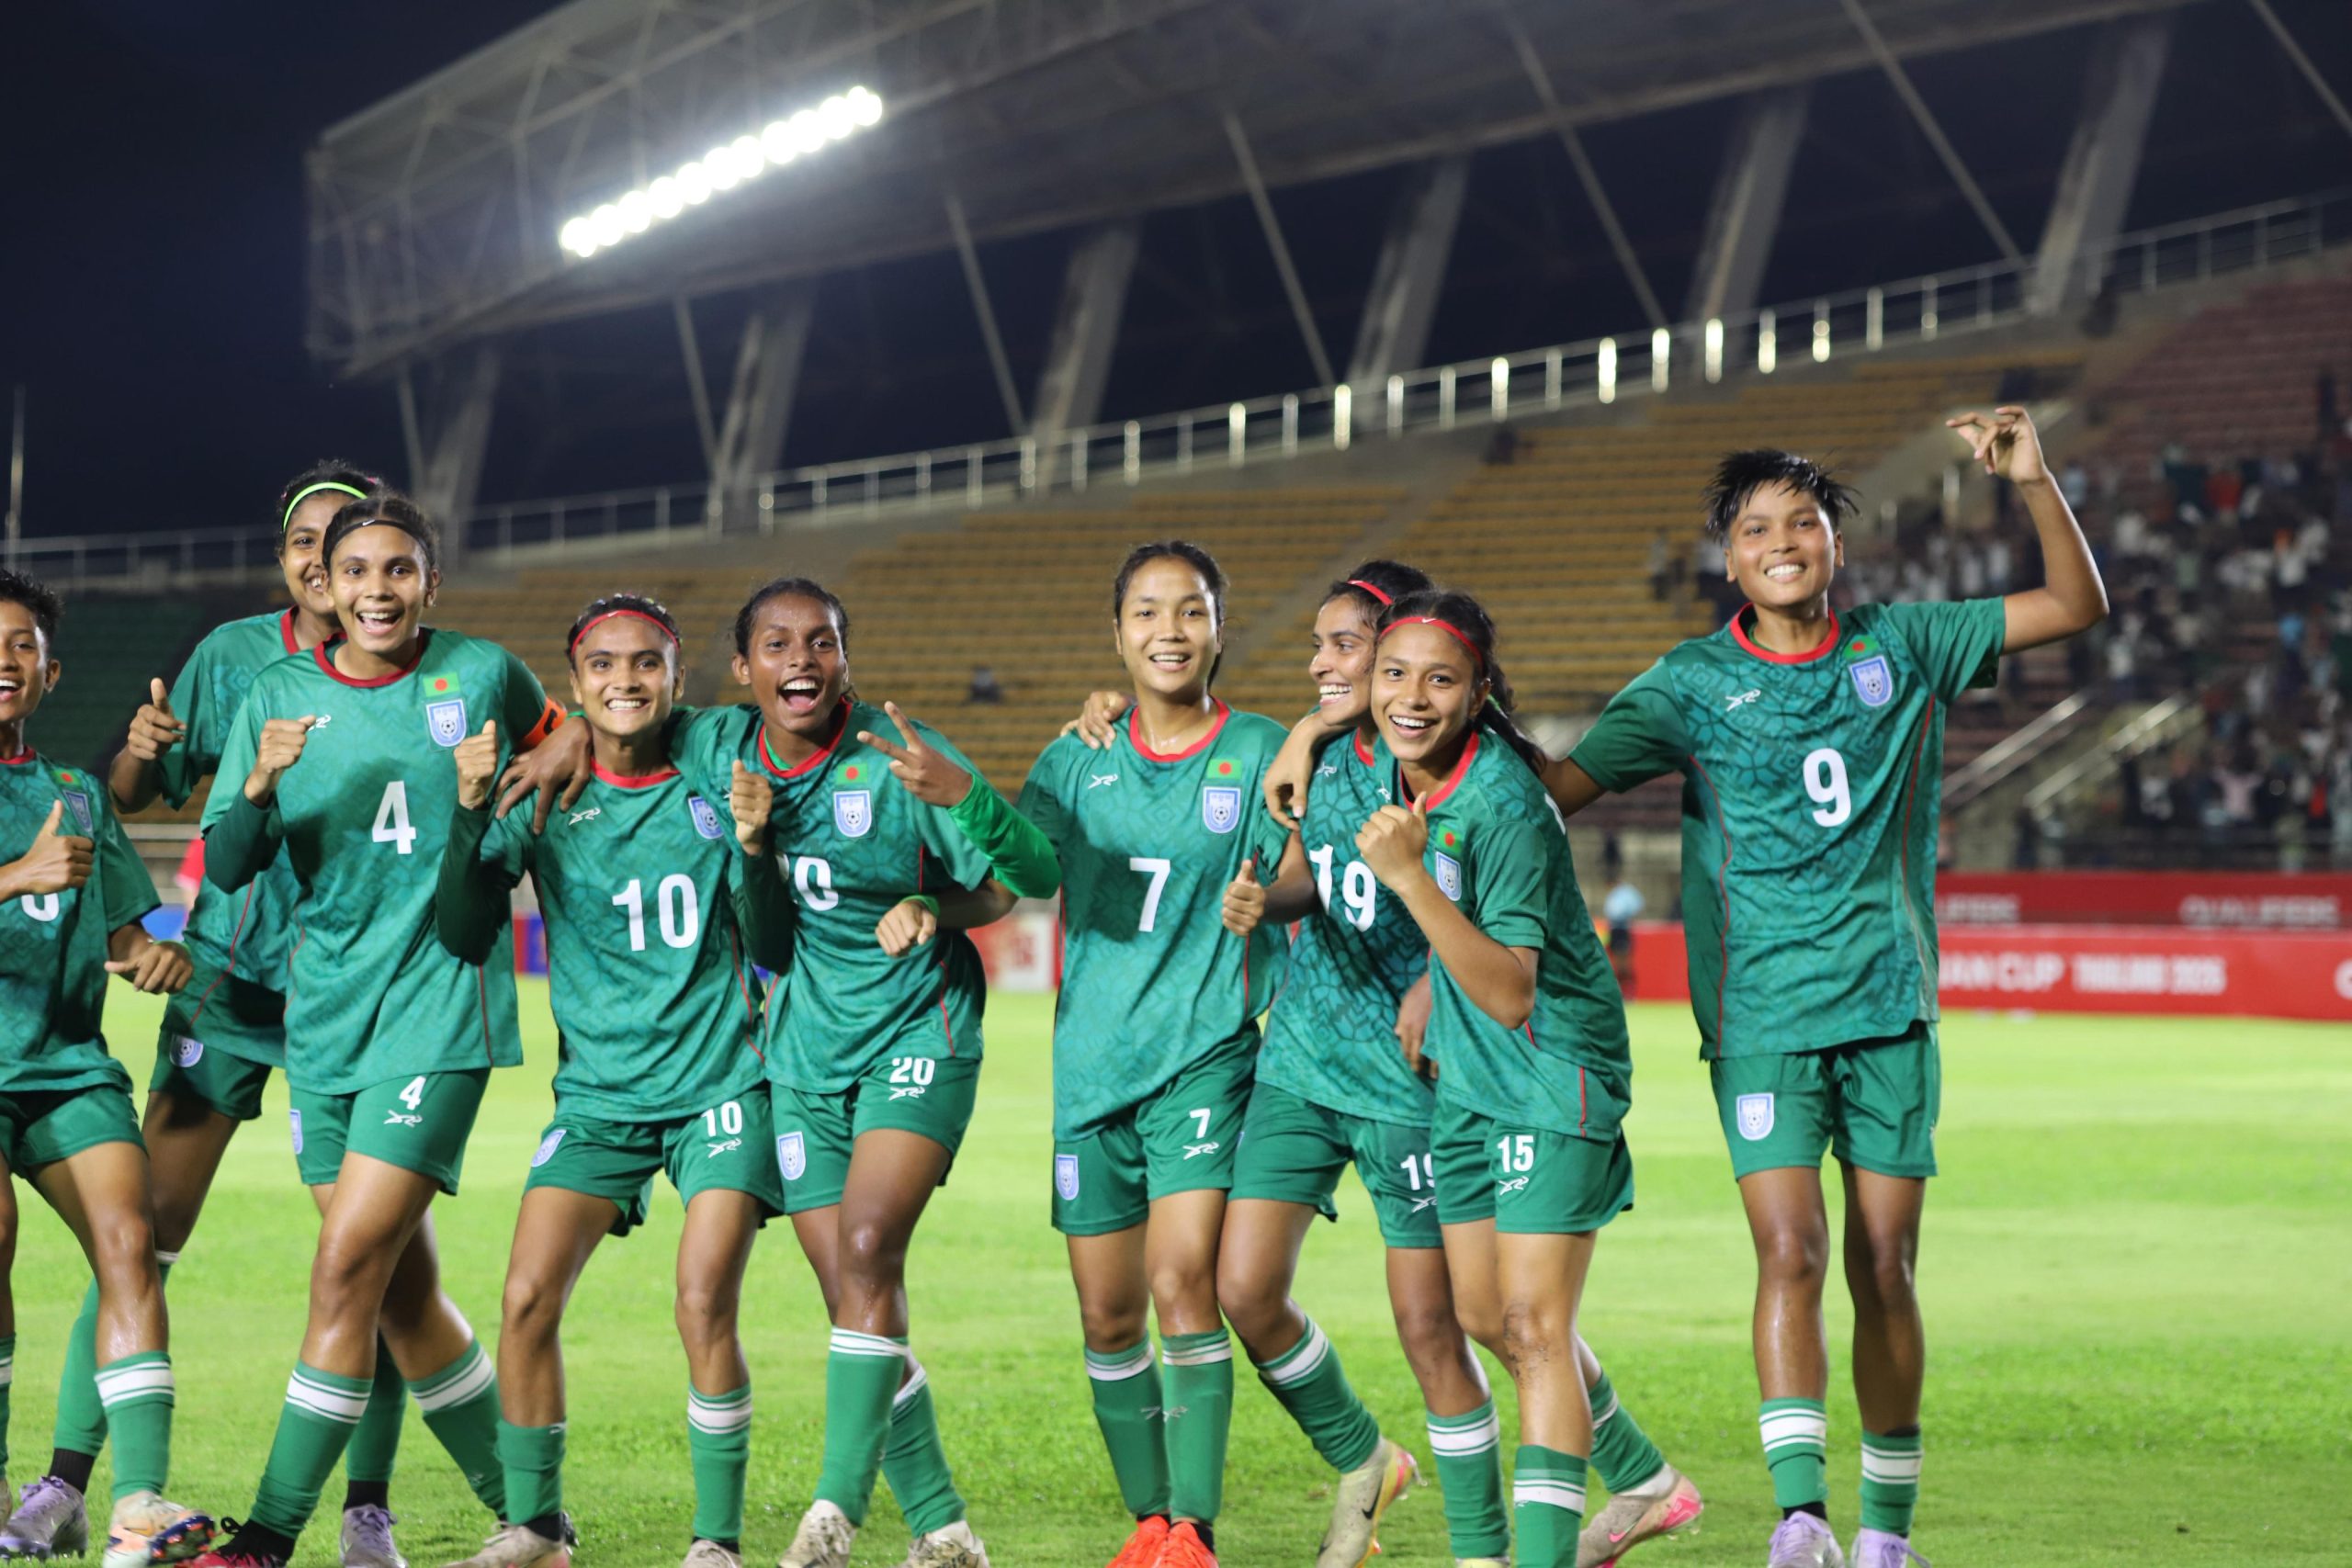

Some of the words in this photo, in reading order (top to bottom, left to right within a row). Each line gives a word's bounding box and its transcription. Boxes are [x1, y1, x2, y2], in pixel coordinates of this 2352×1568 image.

[1803, 748, 1851, 827] 9
[371, 780, 416, 854] 4
[1129, 857, 1170, 932] 7
[1308, 843, 1376, 932] 19
[612, 874, 699, 951] 10
[1997, 952, 2065, 992] CUP
[888, 1057, 934, 1086] 20
[399, 1076, 425, 1110] 4
[702, 1101, 743, 1137] 10
[1189, 1108, 1211, 1139] 7
[1497, 1134, 1535, 1173] 15
